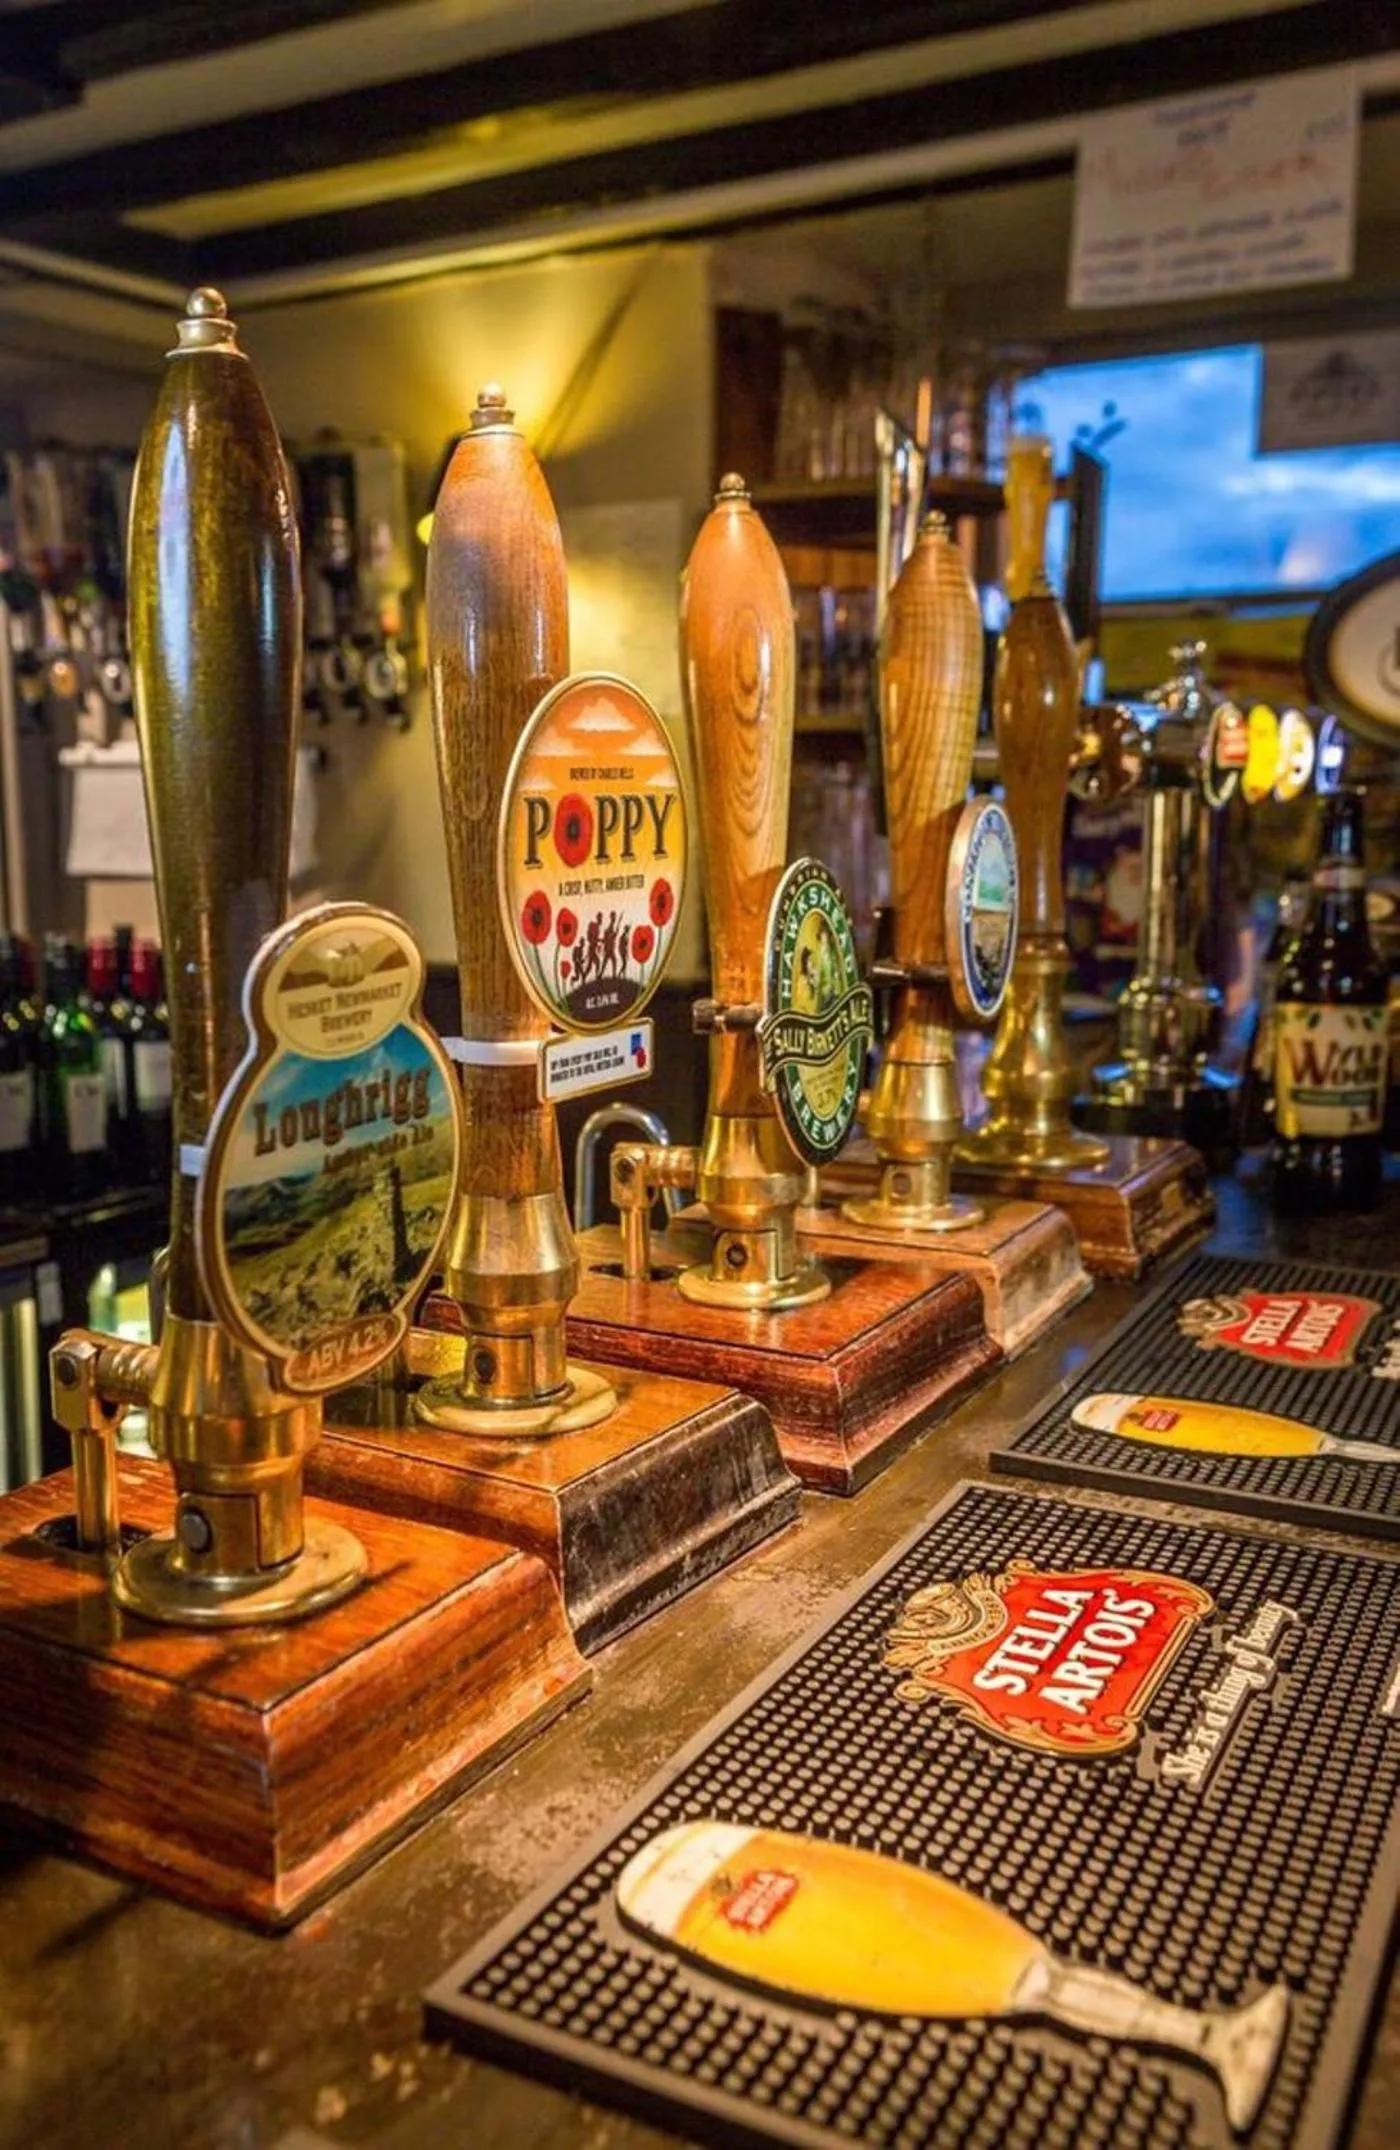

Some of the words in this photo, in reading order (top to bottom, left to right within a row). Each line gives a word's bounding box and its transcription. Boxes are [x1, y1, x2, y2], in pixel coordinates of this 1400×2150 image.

[523, 793, 675, 866] POPPY
[320, 1010, 373, 1033] BREWERY
[773, 1027, 805, 1057] SALLY
[792, 1060, 858, 1143] BREWERY
[307, 1337, 346, 1378] ABV
[973, 1589, 1096, 1697] STELLA
[1231, 1598, 1299, 1653] beauty
[1038, 1588, 1156, 1715] ARTOIS
[1199, 1667, 1267, 1715] thing
[1183, 1725, 1222, 1748] is
[1204, 1710, 1229, 1729] a
[1162, 1740, 1211, 1784] She
